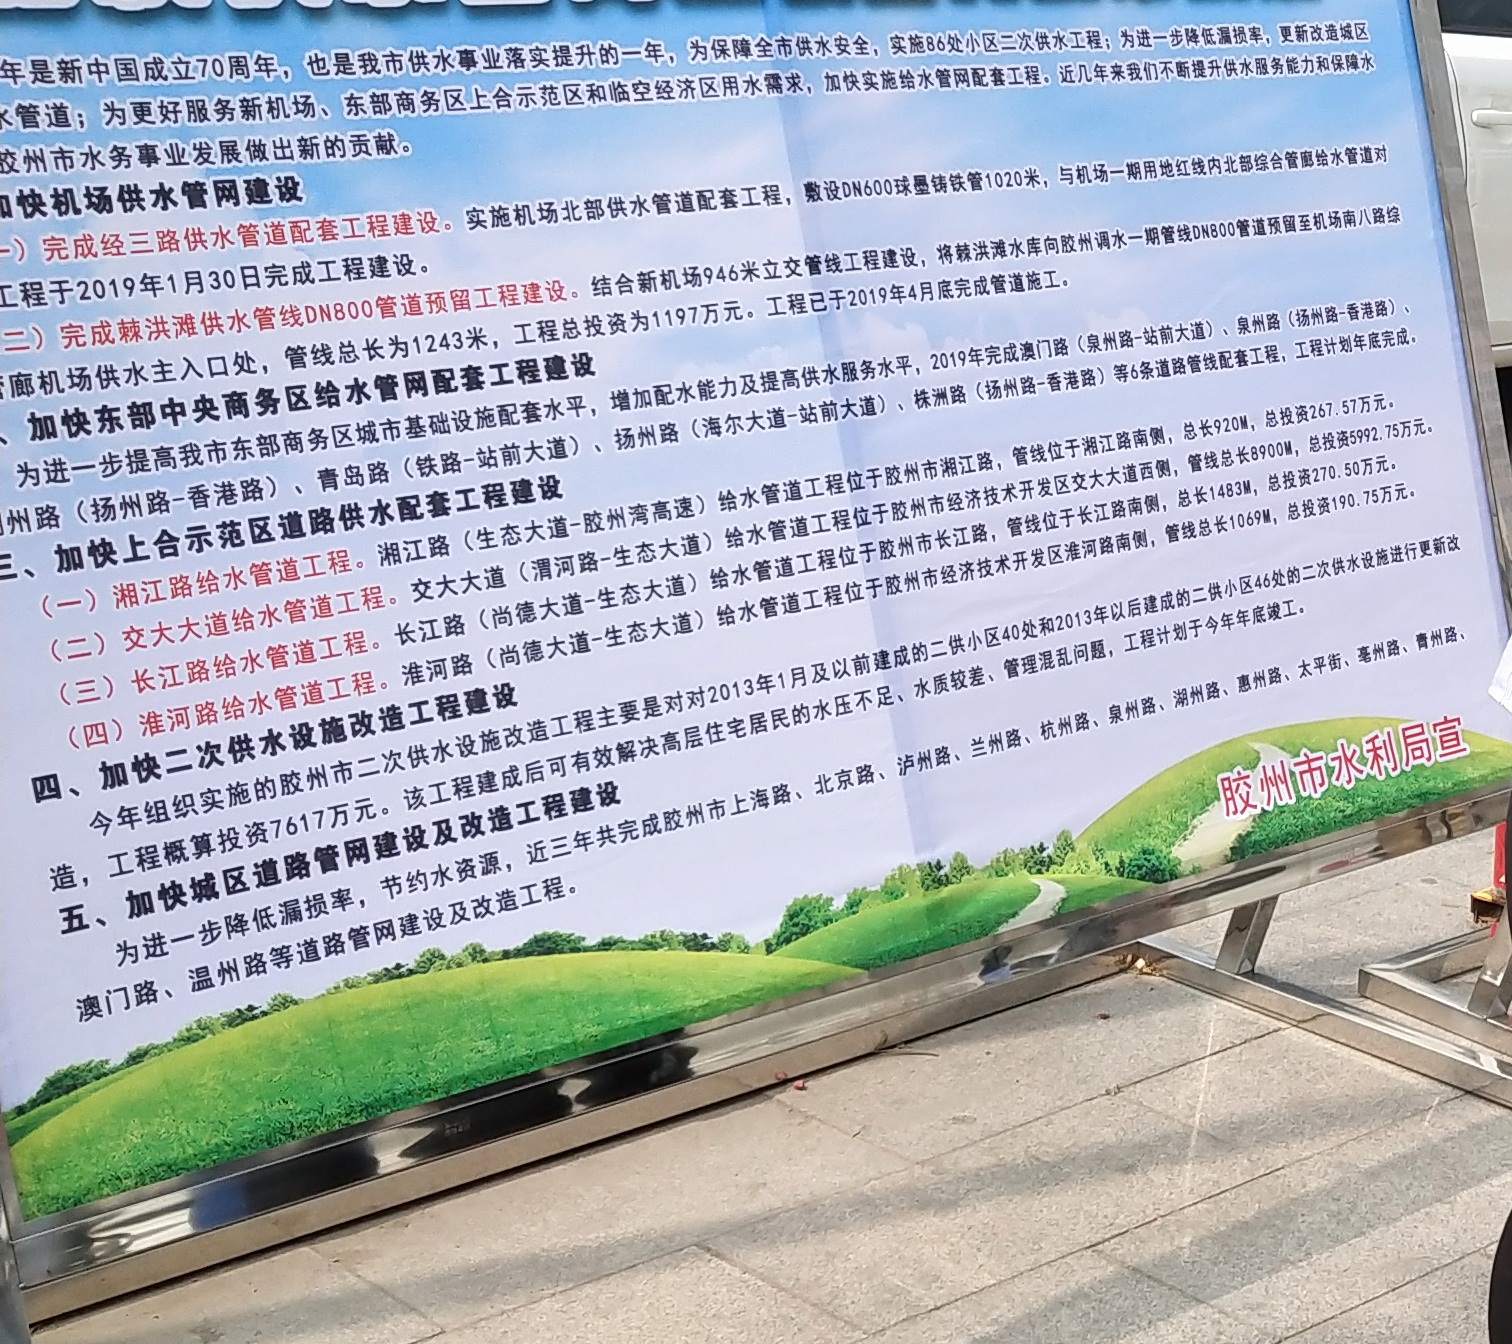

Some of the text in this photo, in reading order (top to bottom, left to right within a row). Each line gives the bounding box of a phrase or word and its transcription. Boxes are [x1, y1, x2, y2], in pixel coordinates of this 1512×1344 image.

[0, 270, 1069, 398] 廊机场供水主入口处，管线总长为1243米，工程总投资为1197万元。工程已于2019年4月底完成管道施工。
[31, 683, 519, 803] 四、加快二次供水设施改造工程建设
[1222, 715, 1469, 817] 胶州市水利局宣
[59, 781, 622, 936] 五、加快城区道路管网建设及改造工程建设
